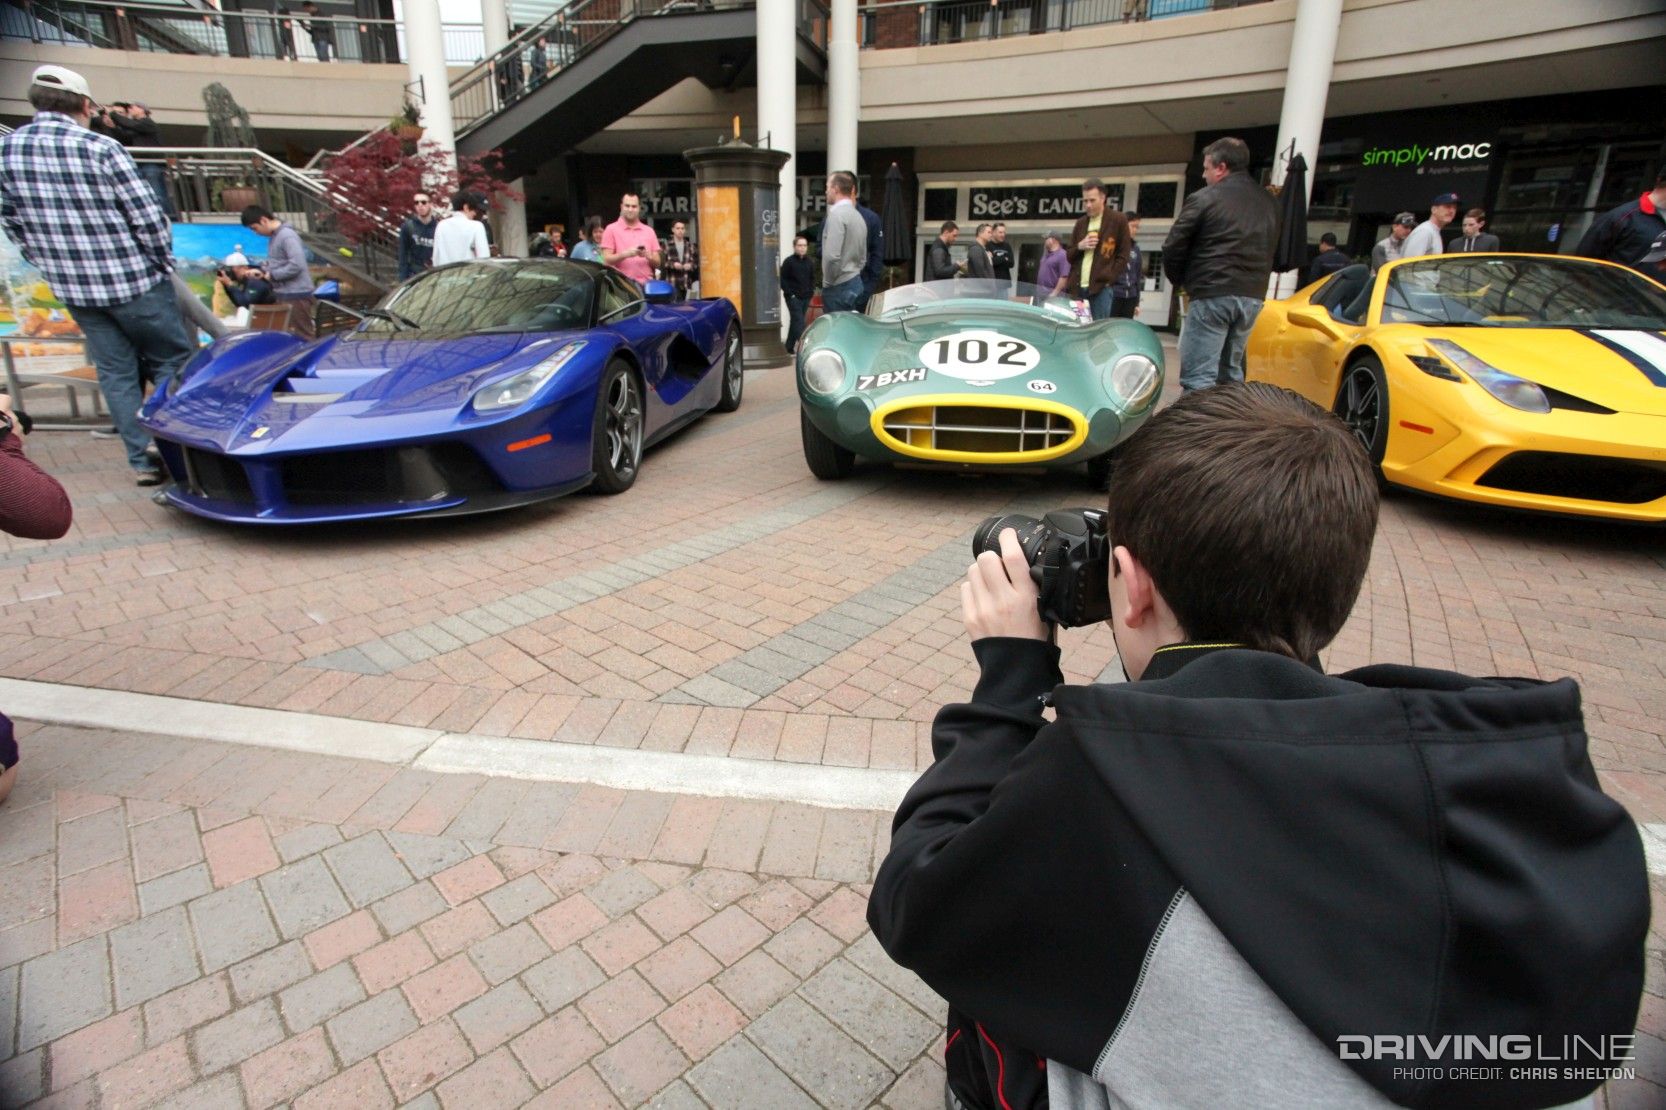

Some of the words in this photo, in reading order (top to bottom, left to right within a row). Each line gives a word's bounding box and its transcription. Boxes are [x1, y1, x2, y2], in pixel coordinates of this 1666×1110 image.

[973, 193, 1028, 216] See's
[1038, 196, 1119, 214] CANDS
[933, 339, 1028, 367] 102
[857, 376, 875, 391] 7
[876, 368, 927, 388] BXH
[1031, 382, 1053, 392] 64
